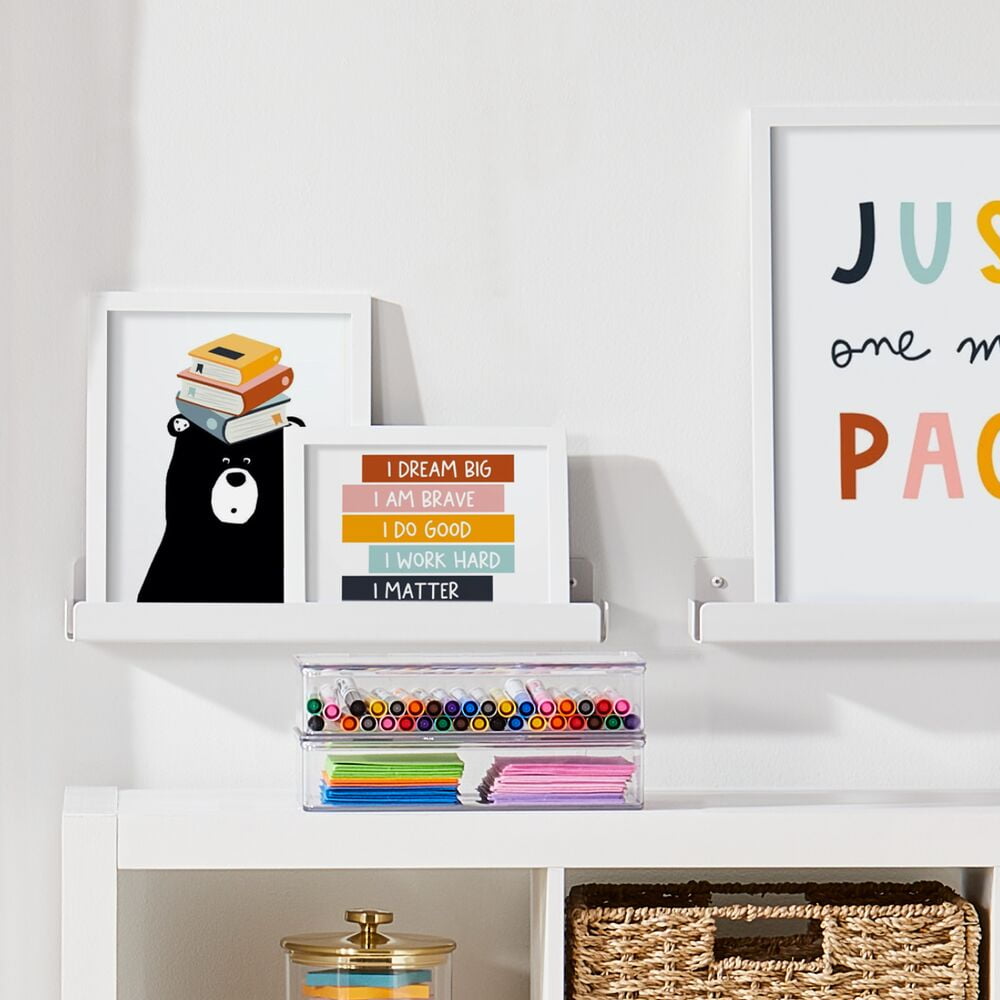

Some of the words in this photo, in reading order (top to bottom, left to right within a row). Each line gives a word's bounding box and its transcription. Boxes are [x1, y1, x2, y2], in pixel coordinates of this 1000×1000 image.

[831, 330, 931, 368] one
[387, 460, 392, 478] I
[398, 460, 458, 478] DREAM
[464, 459, 492, 478] BIG
[374, 491, 379, 507] I
[386, 490, 415, 508] AM
[422, 490, 475, 508] BRAVE
[383, 521, 388, 539] I
[394, 521, 418, 539] DO
[424, 520, 472, 539] GOOD
[385, 552, 389, 569] I
[397, 552, 447, 569] WORK
[454, 551, 501, 569] HARD
[373, 582, 378, 600] I
[385, 581, 460, 600] MATTER
